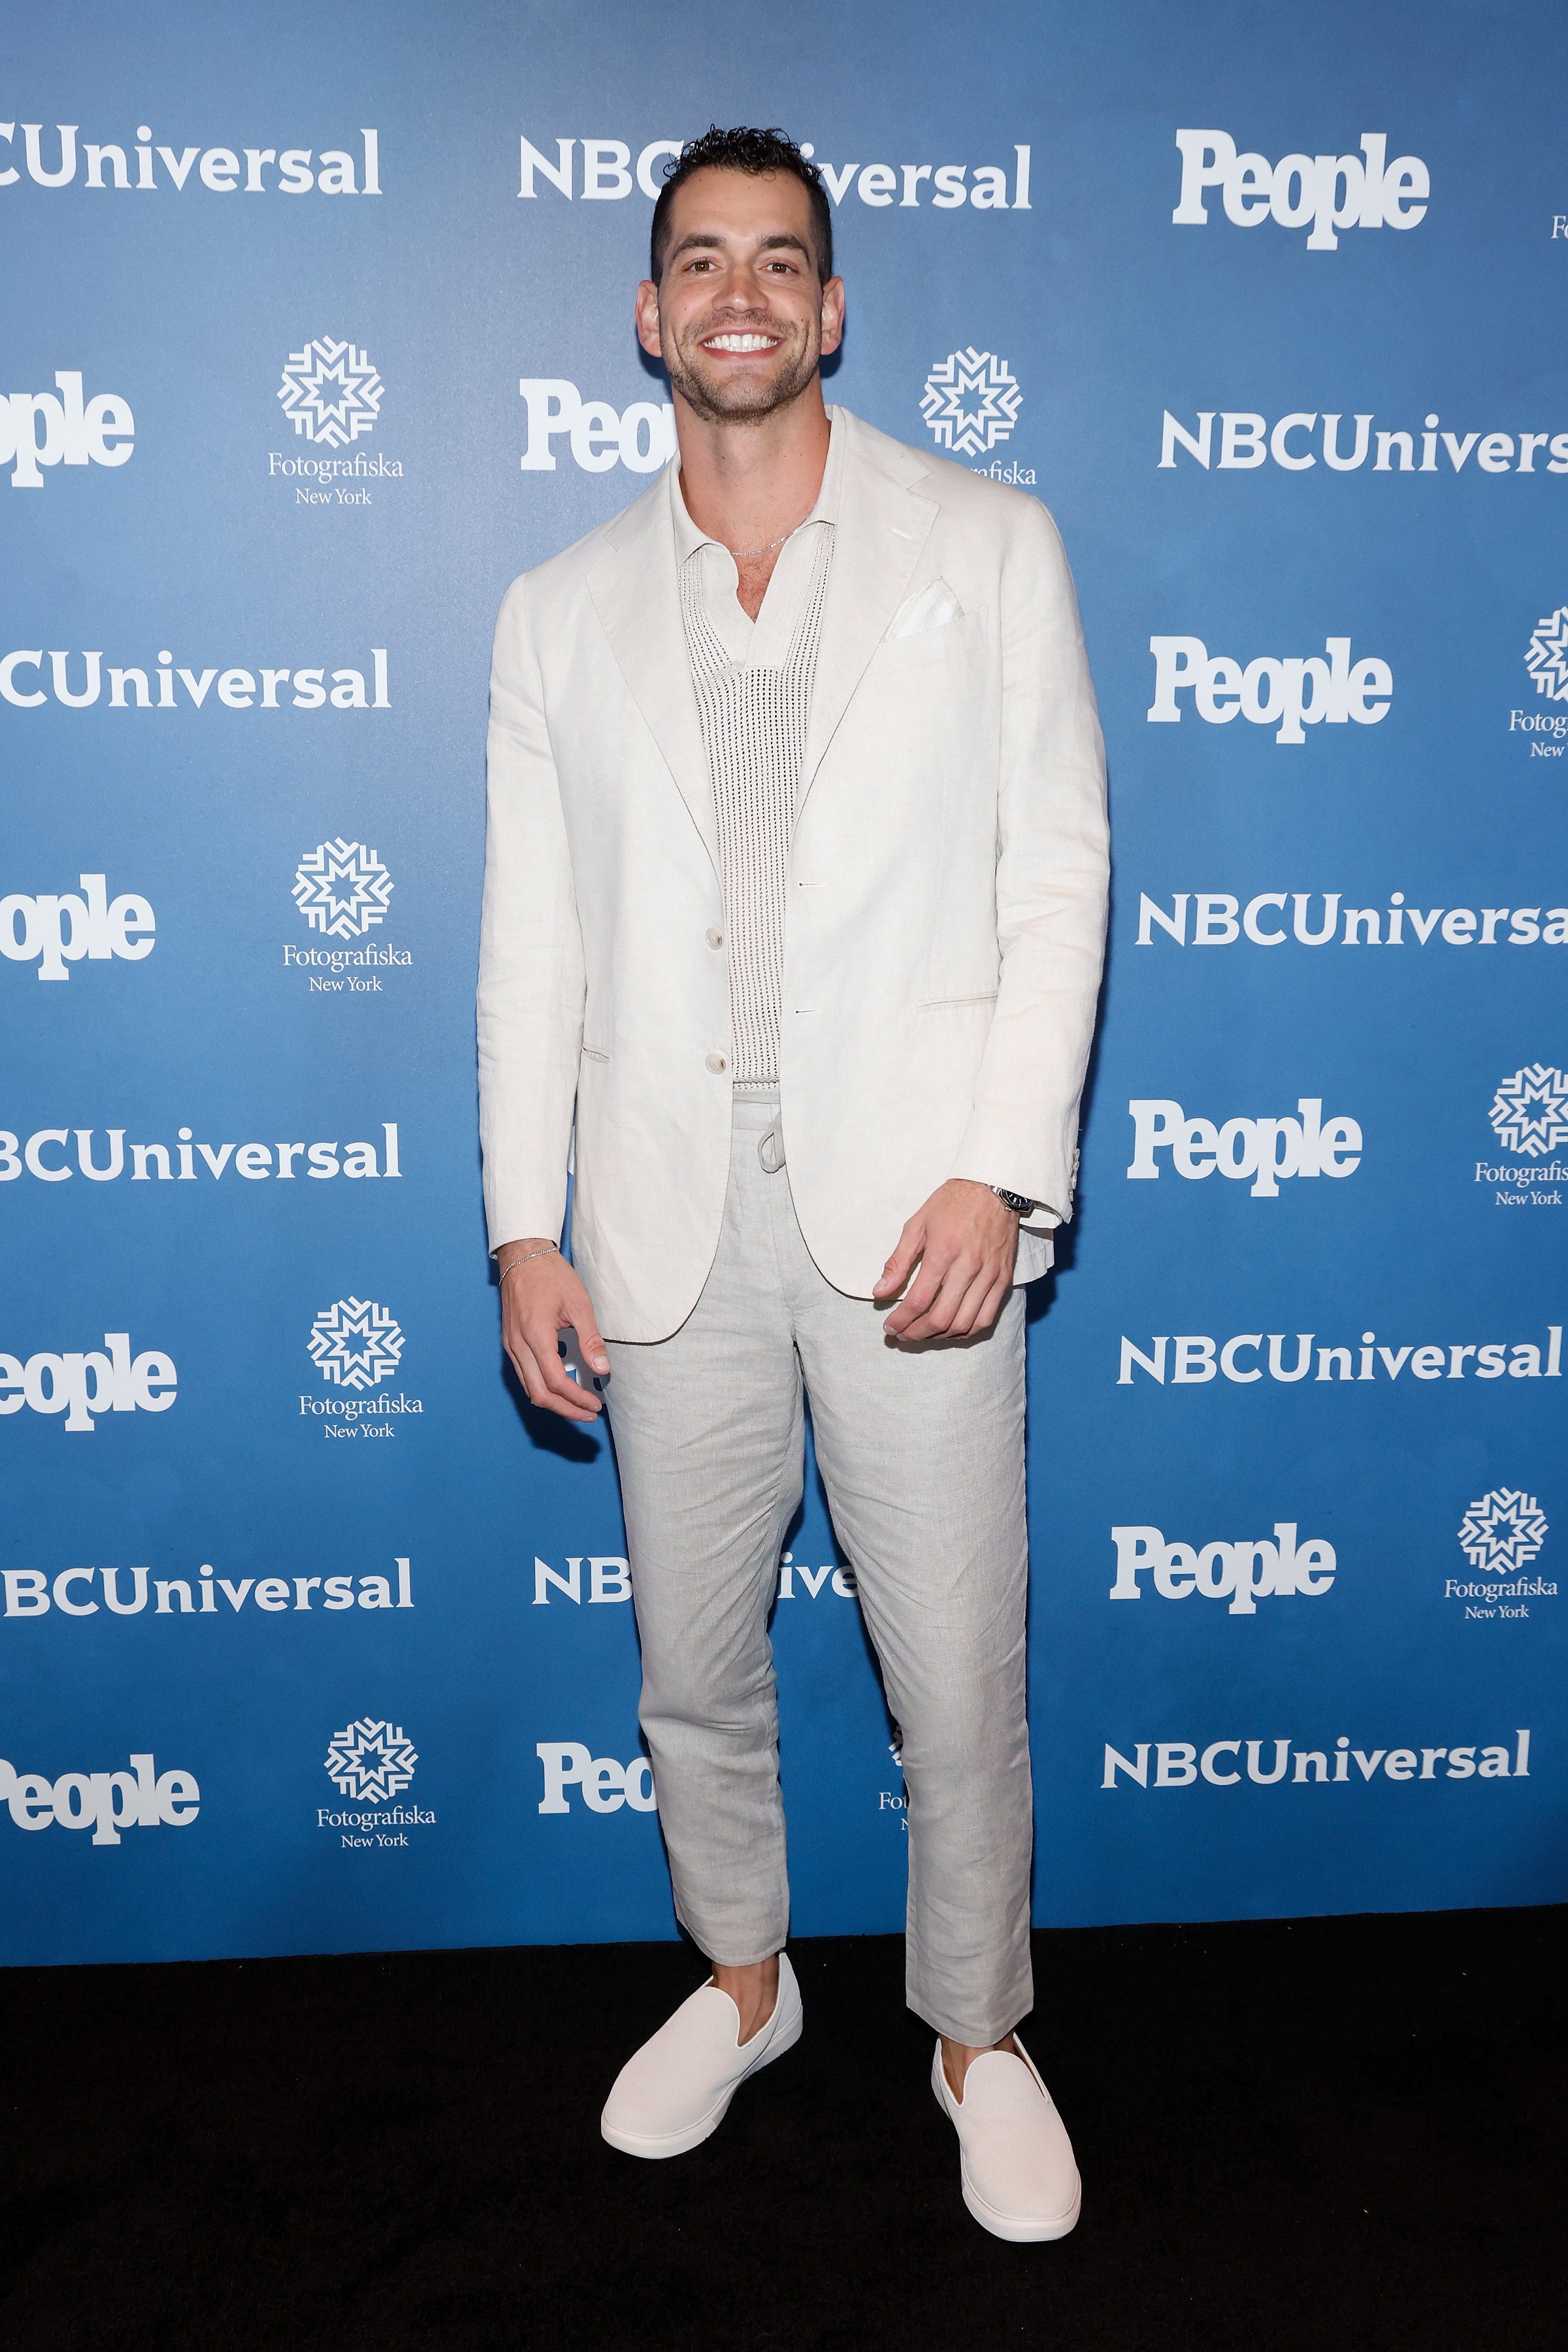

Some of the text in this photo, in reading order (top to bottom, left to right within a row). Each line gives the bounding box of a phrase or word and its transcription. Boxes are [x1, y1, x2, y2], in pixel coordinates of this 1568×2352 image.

[1173, 129, 1430, 250] People
[1157, 410, 1568, 473] NBCUnivers
[268, 451, 404, 483] Fotografiska
[295, 487, 372, 504] New York
[0, 648, 392, 708] CUniversal
[1147, 636, 1393, 743] People
[1509, 710, 1568, 739] Fotog
[1530, 742, 1565, 757] New
[0, 874, 156, 981] ople
[1135, 892, 1568, 946] NBCUniversa
[282, 943, 413, 972] Fotografiska
[308, 976, 383, 991] New York
[1127, 1098, 1363, 1197] People
[1474, 1160, 1568, 1188] Fotografis
[1495, 1190, 1563, 1205] New York
[1116, 1326, 1562, 1385] NBCUniversal
[299, 1393, 424, 1420] Fotografiska
[323, 1423, 395, 1438] New York
[1109, 1522, 1336, 1614] People
[0, 1558, 415, 1616] BCUniversal
[1444, 1576, 1558, 1603] Fotografiska
[1465, 1605, 1529, 1619] New York
[1100, 1729, 1531, 1789] NBCUniversal
[317, 1805, 436, 1831] Fotografiska
[340, 1833, 409, 1848] New York
